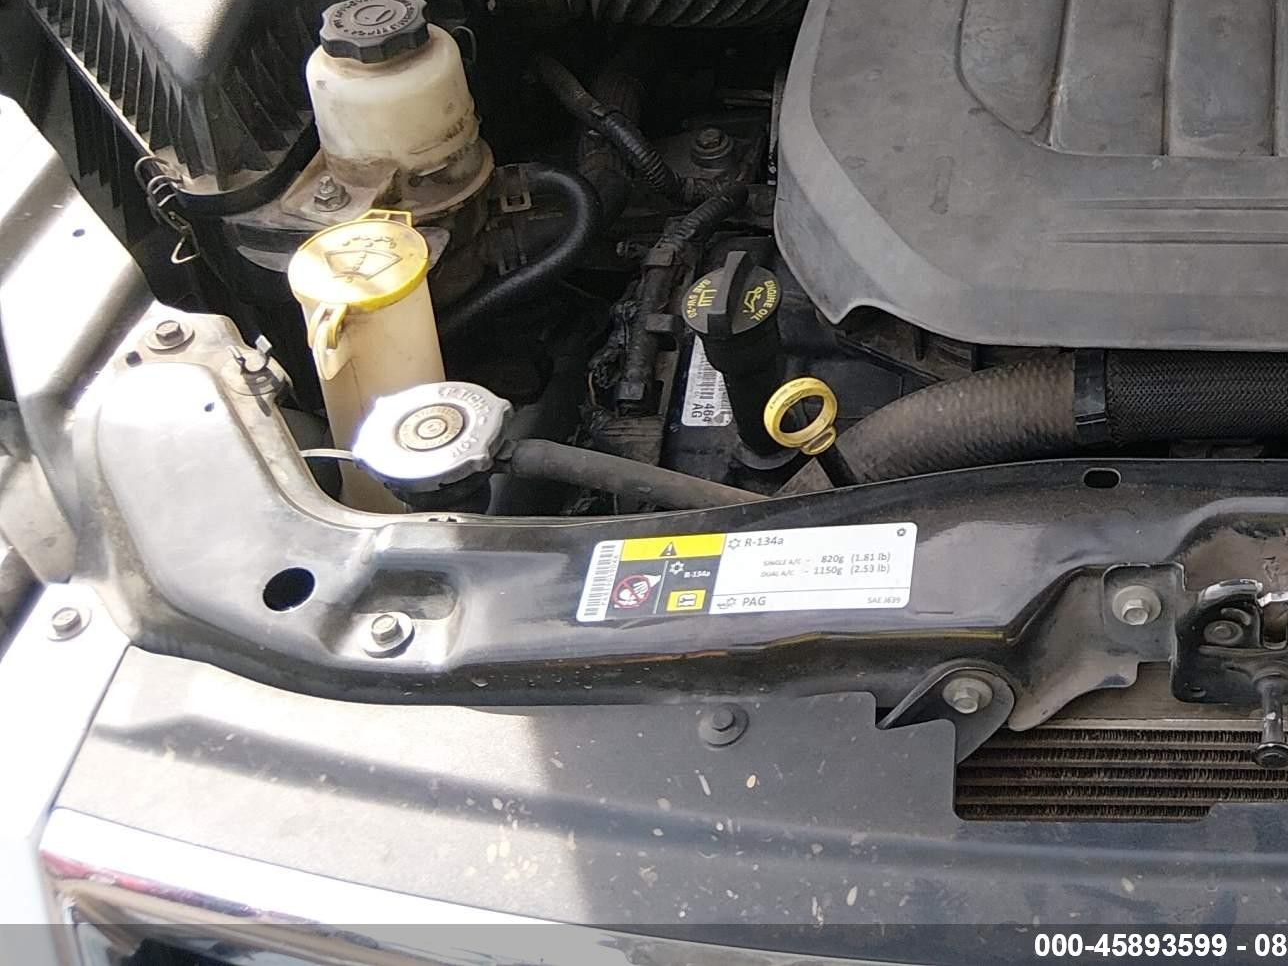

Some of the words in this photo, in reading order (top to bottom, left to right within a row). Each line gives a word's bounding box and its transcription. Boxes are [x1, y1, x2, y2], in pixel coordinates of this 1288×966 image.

[692, 279, 712, 293] SAE
[764, 280, 777, 307] ENGINE
[750, 309, 768, 321] OIL
[745, 537, 784, 547] R-134a
[821, 555, 844, 564] 820g
[851, 554, 874, 563] (1.81
[878, 553, 891, 562] lb)
[814, 567, 843, 575] 1150g
[850, 565, 874, 574] (2.53
[878, 564, 890, 573] lb)
[742, 596, 766, 606] PAG
